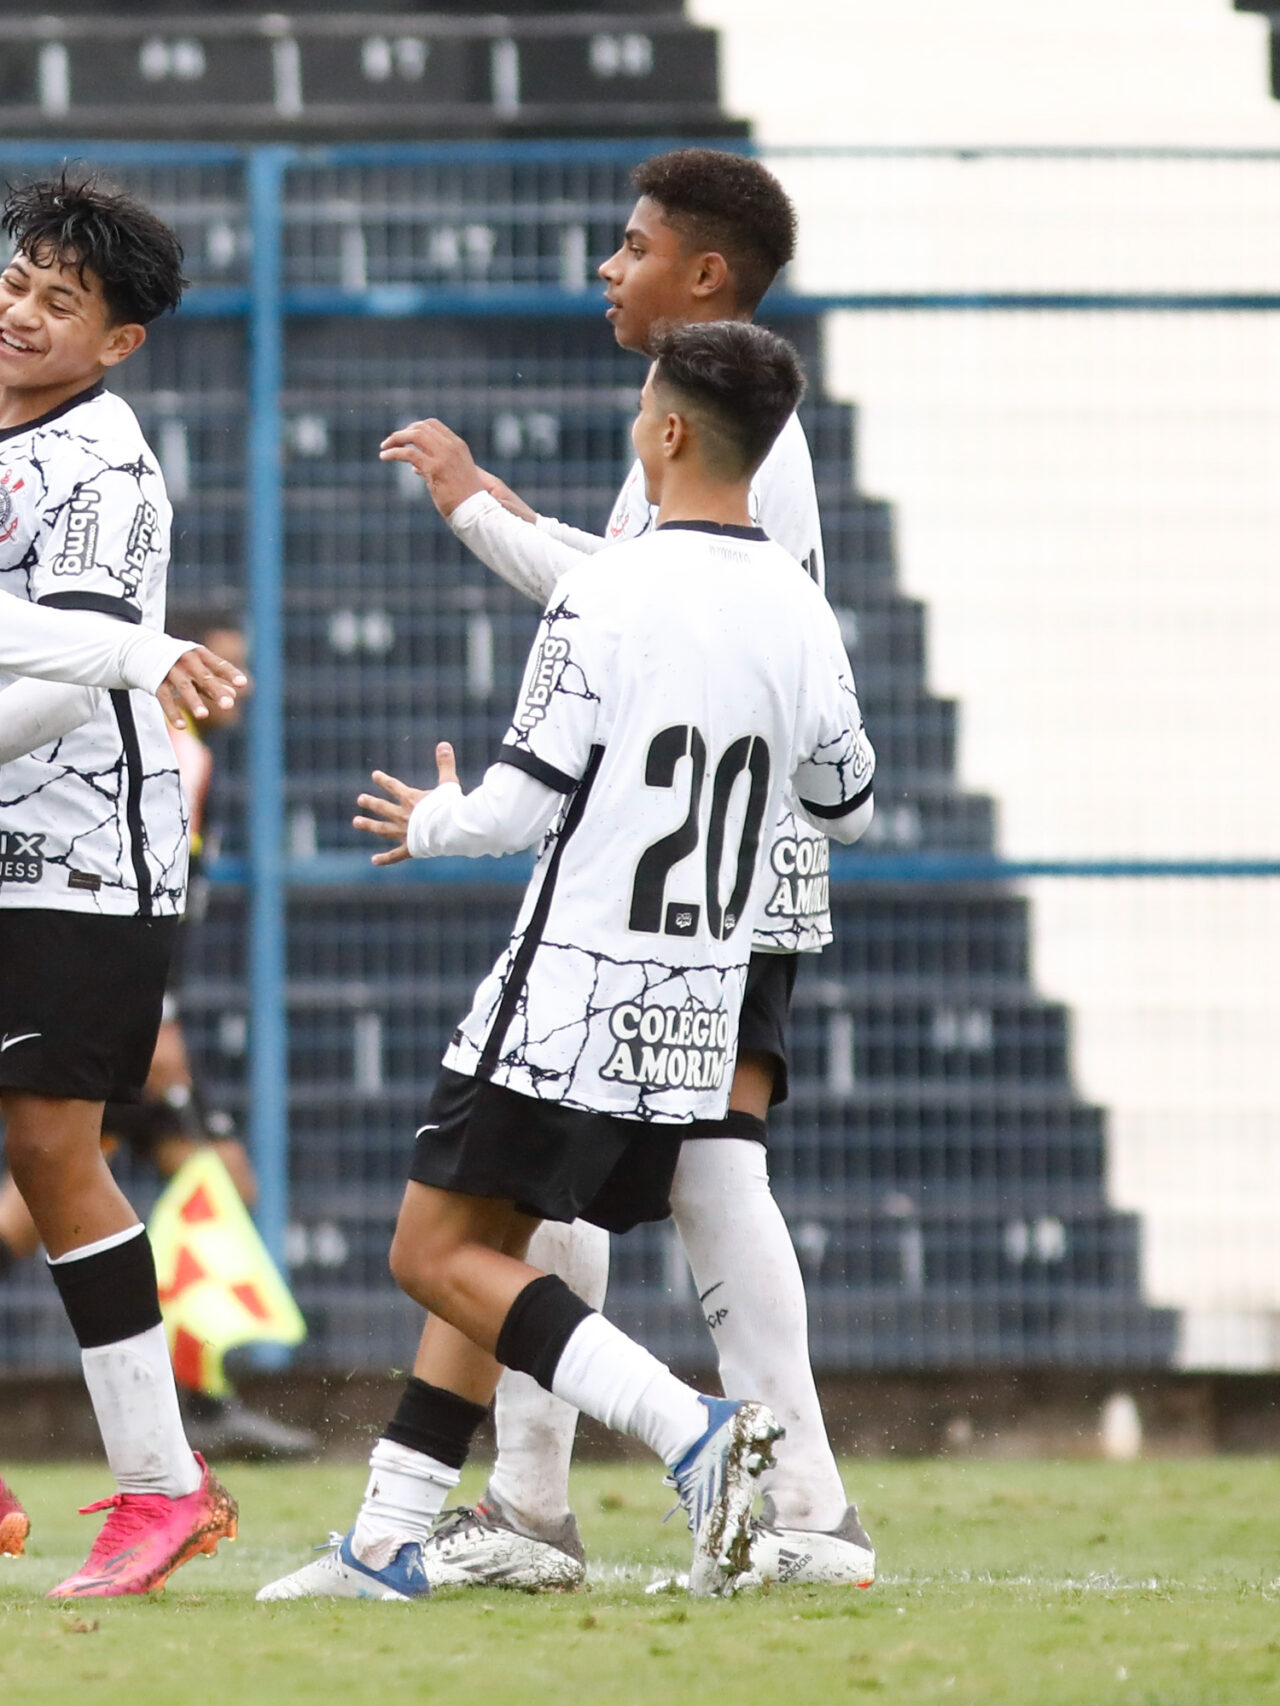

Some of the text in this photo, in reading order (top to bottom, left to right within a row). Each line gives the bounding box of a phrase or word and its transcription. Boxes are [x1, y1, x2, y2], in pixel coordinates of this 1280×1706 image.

[53, 511, 98, 576] bmg
[125, 502, 157, 571] bmg
[526, 637, 569, 706] bmg
[630, 725, 770, 941] 20
[610, 998, 729, 1048] COLÉGIO
[601, 1041, 727, 1088] AMORIM
